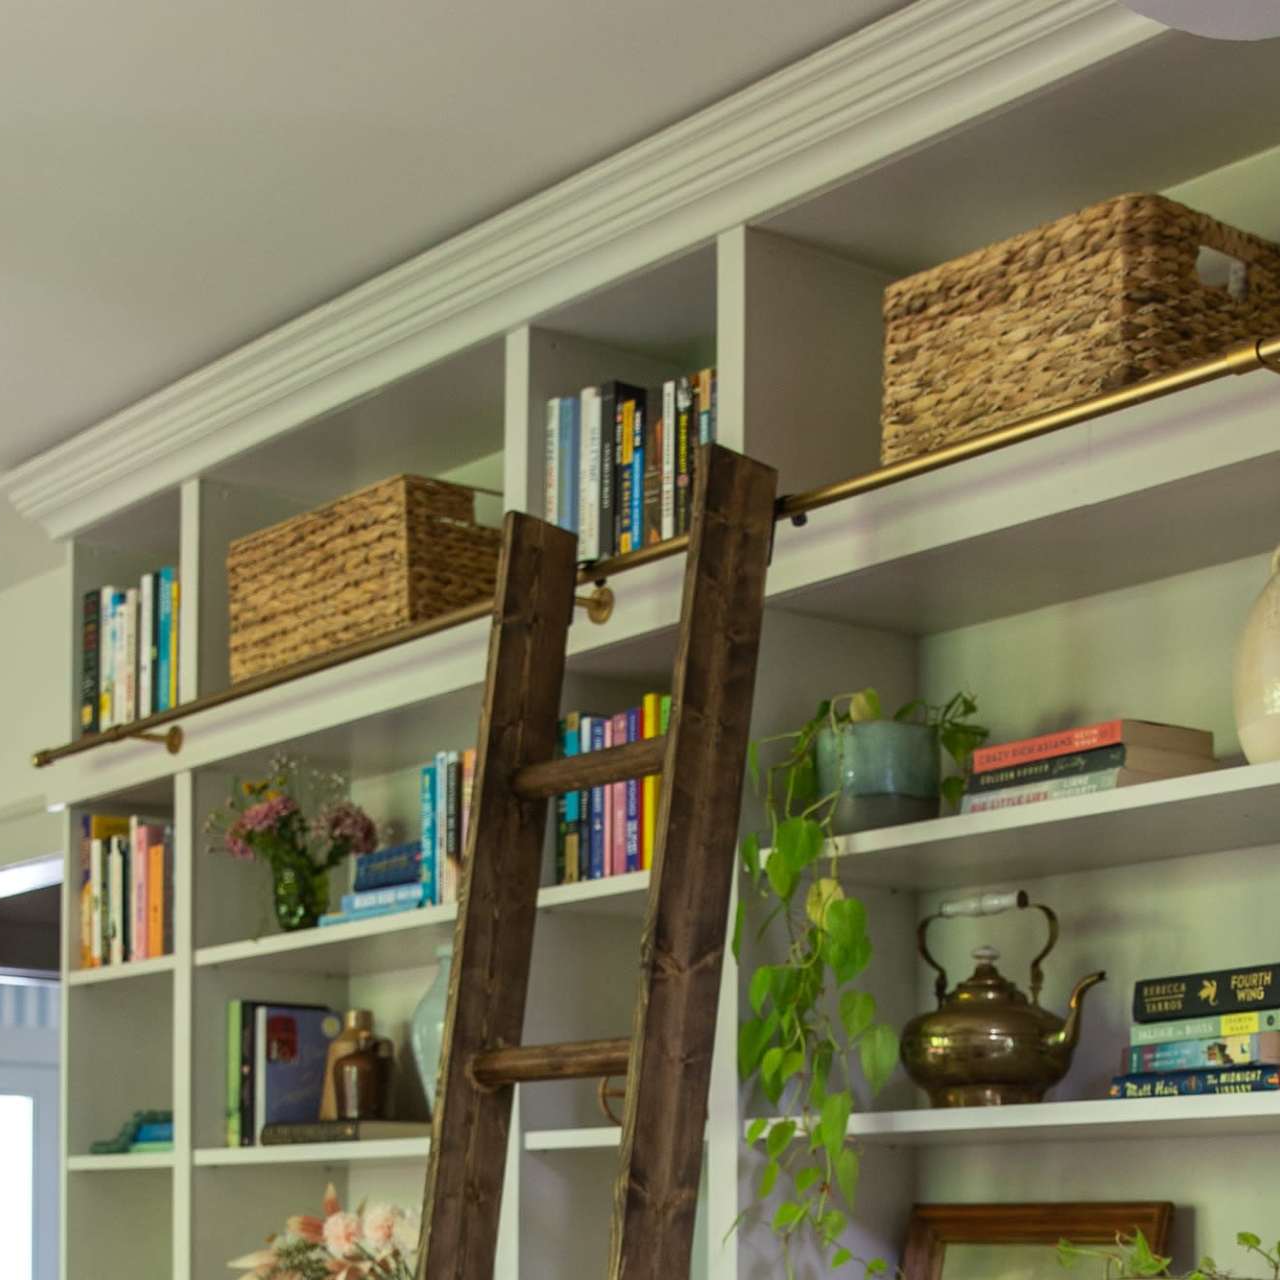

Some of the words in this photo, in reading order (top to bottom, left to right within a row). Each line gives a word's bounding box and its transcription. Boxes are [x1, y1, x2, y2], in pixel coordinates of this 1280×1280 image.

[1231, 971, 1272, 990] FOURTH
[1144, 982, 1186, 996] REBECCA
[1236, 987, 1265, 1002] WING
[1220, 1070, 1262, 1083] MIDNIGHT
